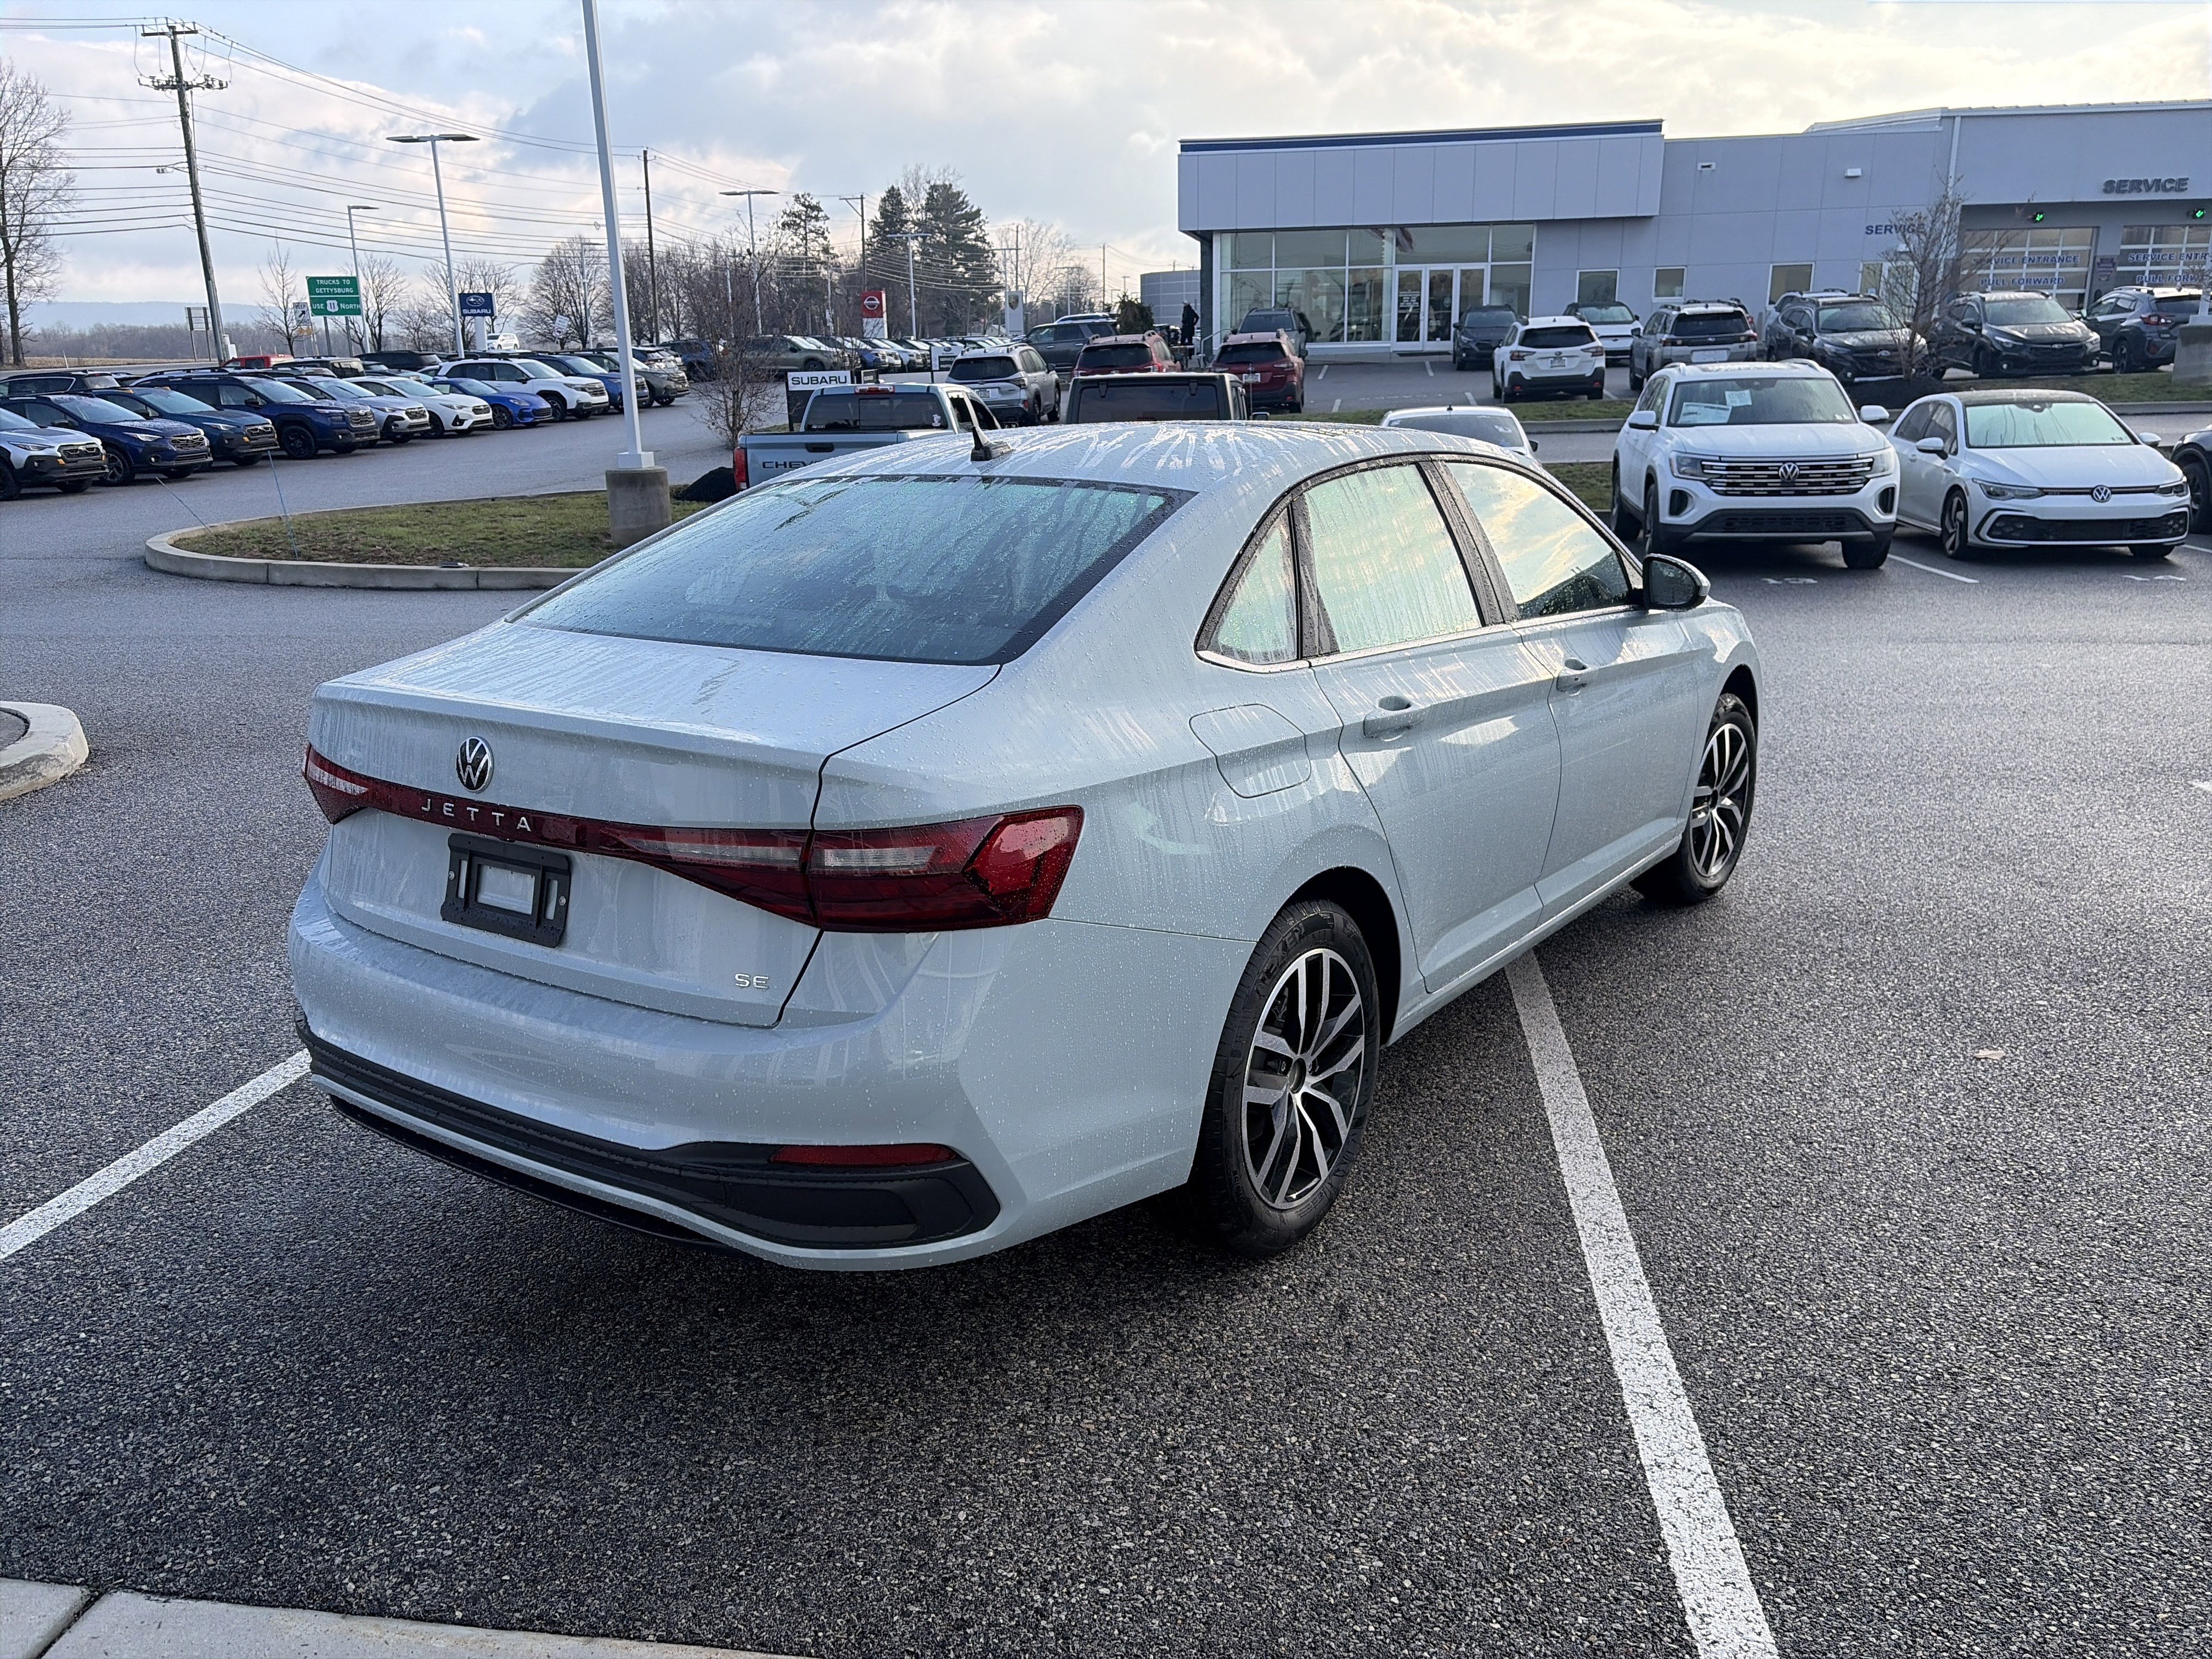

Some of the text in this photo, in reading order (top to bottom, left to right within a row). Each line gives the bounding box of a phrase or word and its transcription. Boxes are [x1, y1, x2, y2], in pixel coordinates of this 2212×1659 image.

[2103, 177, 2189, 194] SERVICE
[2022, 255, 2079, 264] ENTRANCE
[2129, 253, 2175, 261] SERVICE
[2011, 276, 2064, 285] FORWARD
[2137, 275, 2164, 283] PULL
[791, 375, 848, 385] SUBARU
[762, 461, 823, 469] CHEV
[421, 799, 532, 832] JETTA
[735, 973, 769, 989] SE
